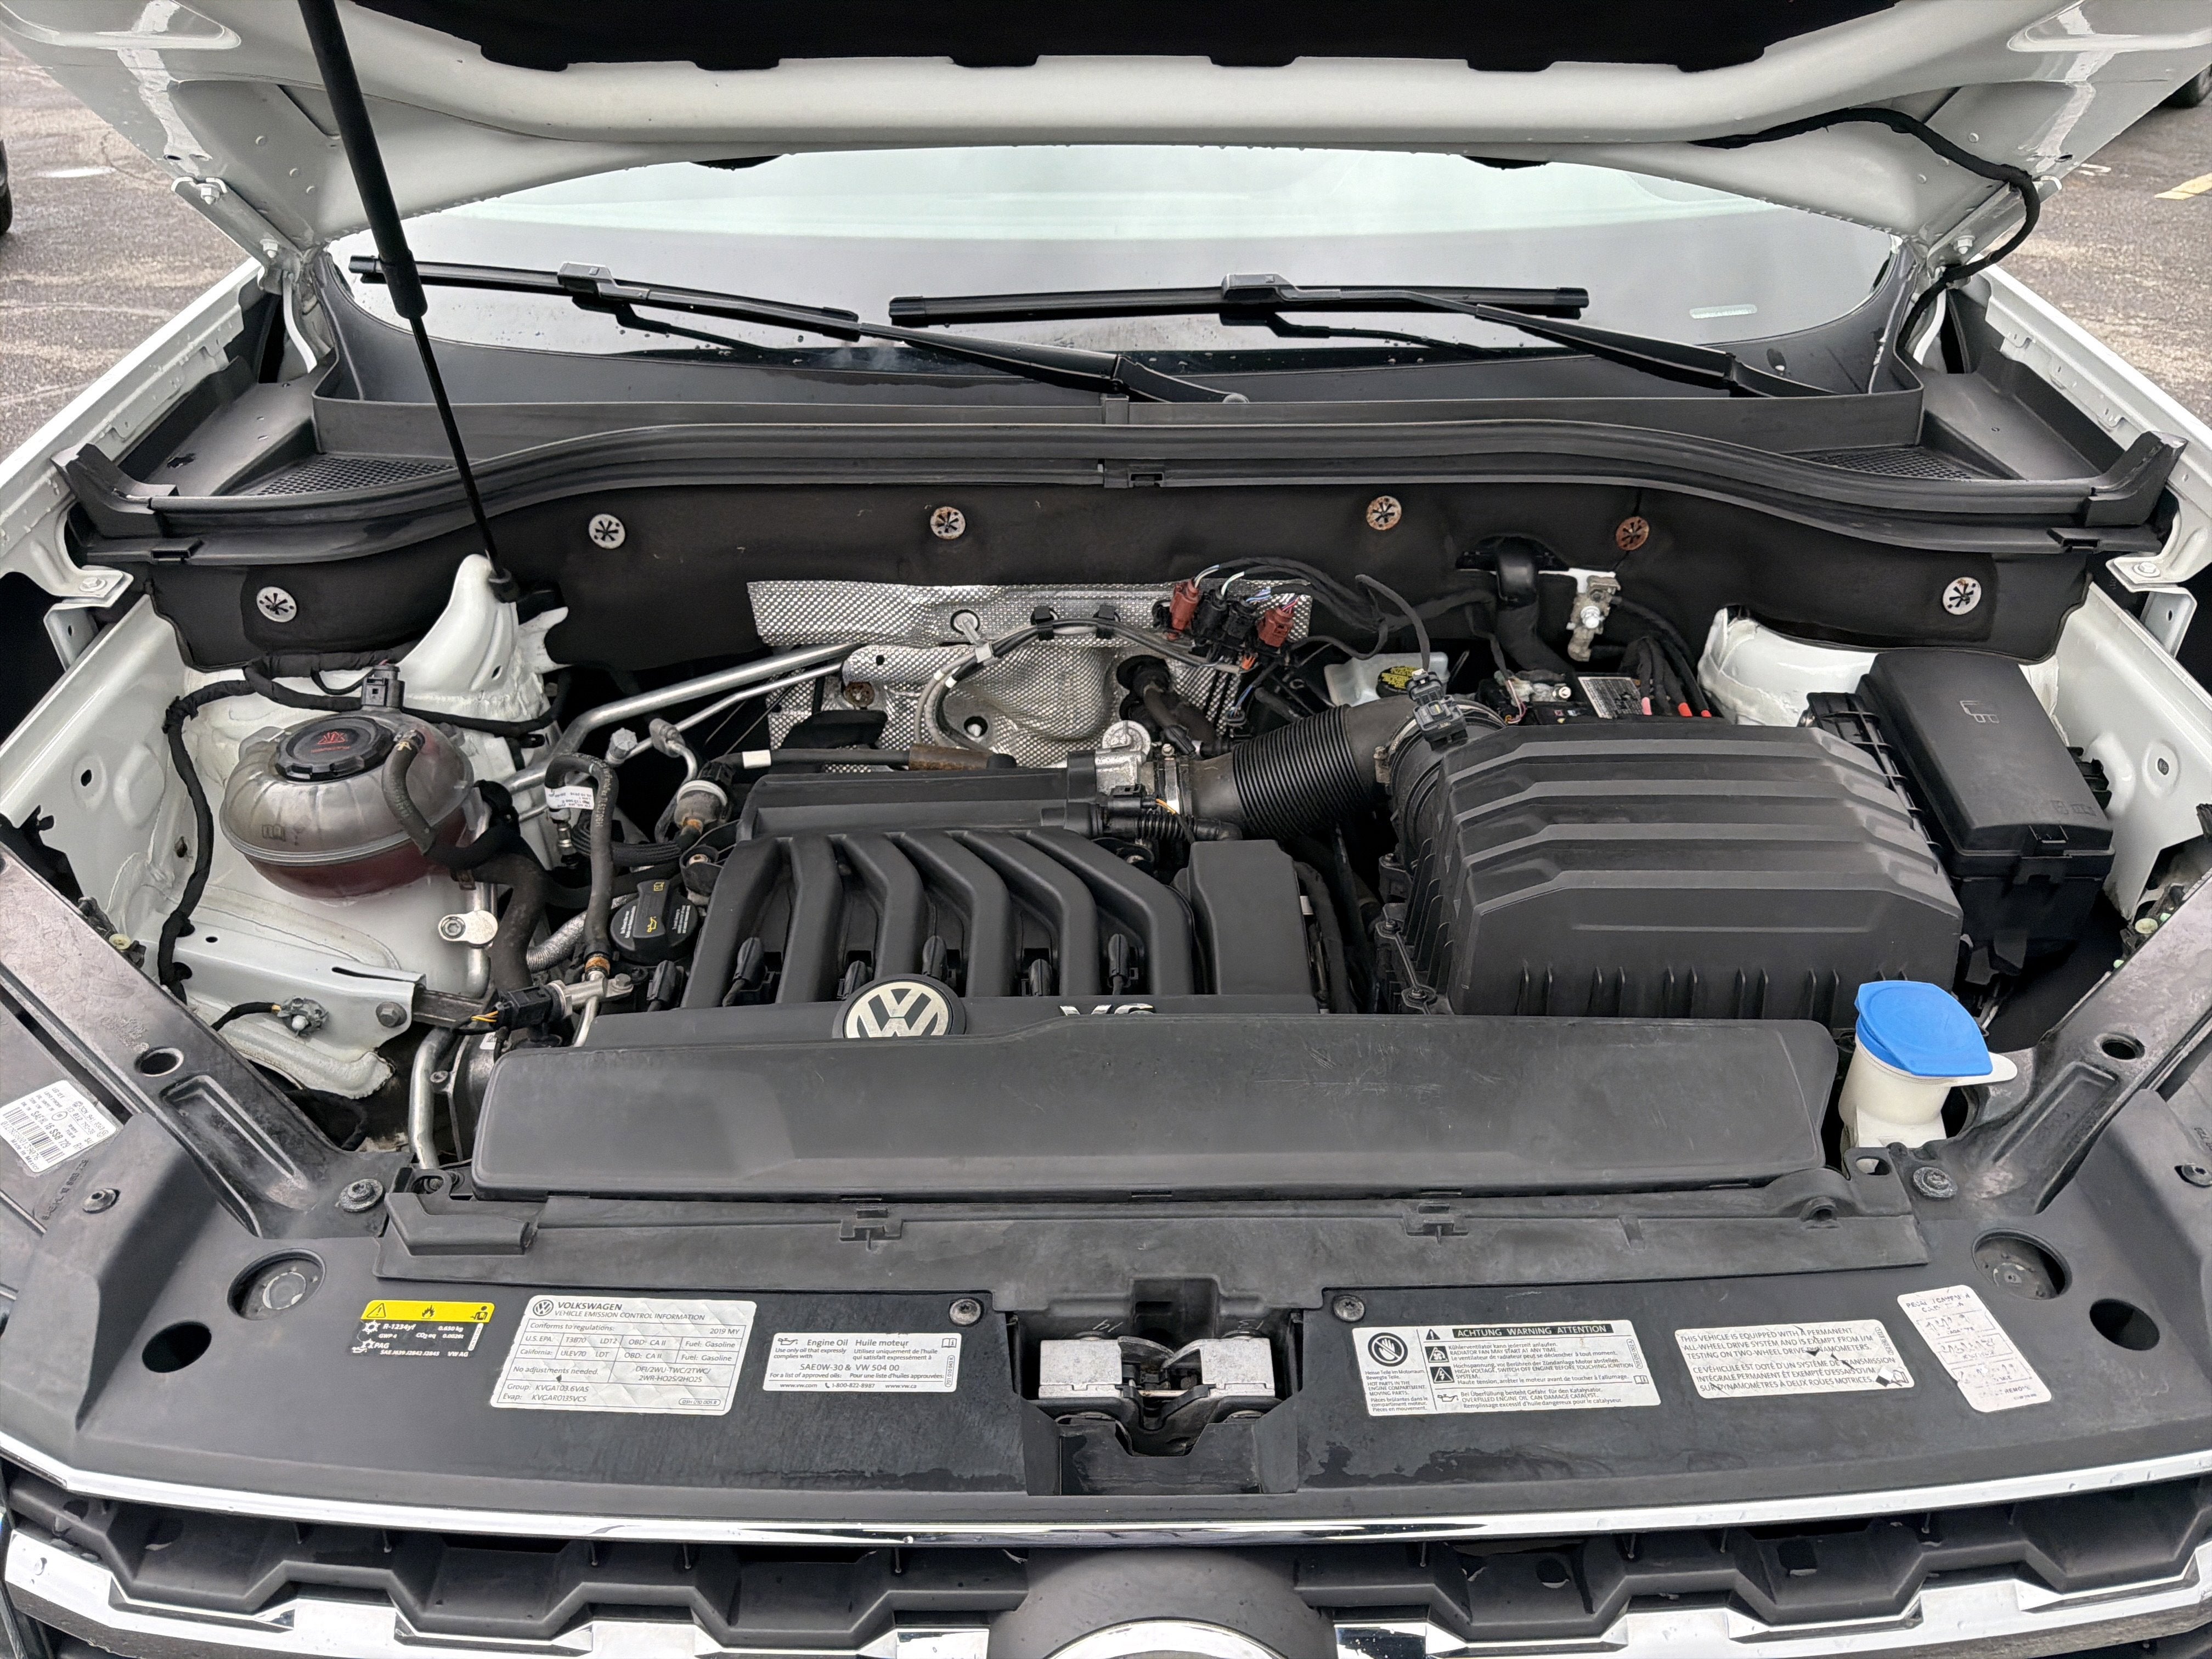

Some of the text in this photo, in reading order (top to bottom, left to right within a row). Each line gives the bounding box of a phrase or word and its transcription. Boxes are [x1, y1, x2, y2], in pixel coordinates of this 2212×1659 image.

[25, 1155, 40, 1171] Mexico
[557, 1301, 622, 1310] VOLKSWAGEN
[654, 1313, 705, 1321] INFORMATION
[1457, 1325, 1606, 1337] ACHTUNG WARNING ATTENTION
[1697, 1333, 1730, 1341] VEHICLE
[1738, 1330, 1777, 1340] EQUIPPED
[1806, 1327, 1852, 1336] PERMANENT
[806, 1339, 834, 1347] Engine
[878, 1339, 909, 1347] moteur
[1683, 1342, 1726, 1351] ALL-WHEEL
[1806, 1336, 1835, 1345] EXEMPT
[1686, 1351, 1719, 1359] TESTING
[1733, 1348, 1782, 1357] TWO-WHEEL
[524, 1366, 569, 1375] adjustments
[1702, 1364, 1741, 1373] VÉHICULE
[1754, 1362, 1775, 1370] DOTÉ
[1829, 1358, 1840, 1367] DE
[1736, 1372, 1780, 1380] PERMANENT
[1781, 1370, 1790, 1378] ET
[1791, 1368, 1824, 1378] EXEMPTÉ
[1700, 1383, 1716, 1391] SUR
[1785, 1379, 1808, 1387] DEUX
[1808, 1377, 1835, 1386] ROUES
